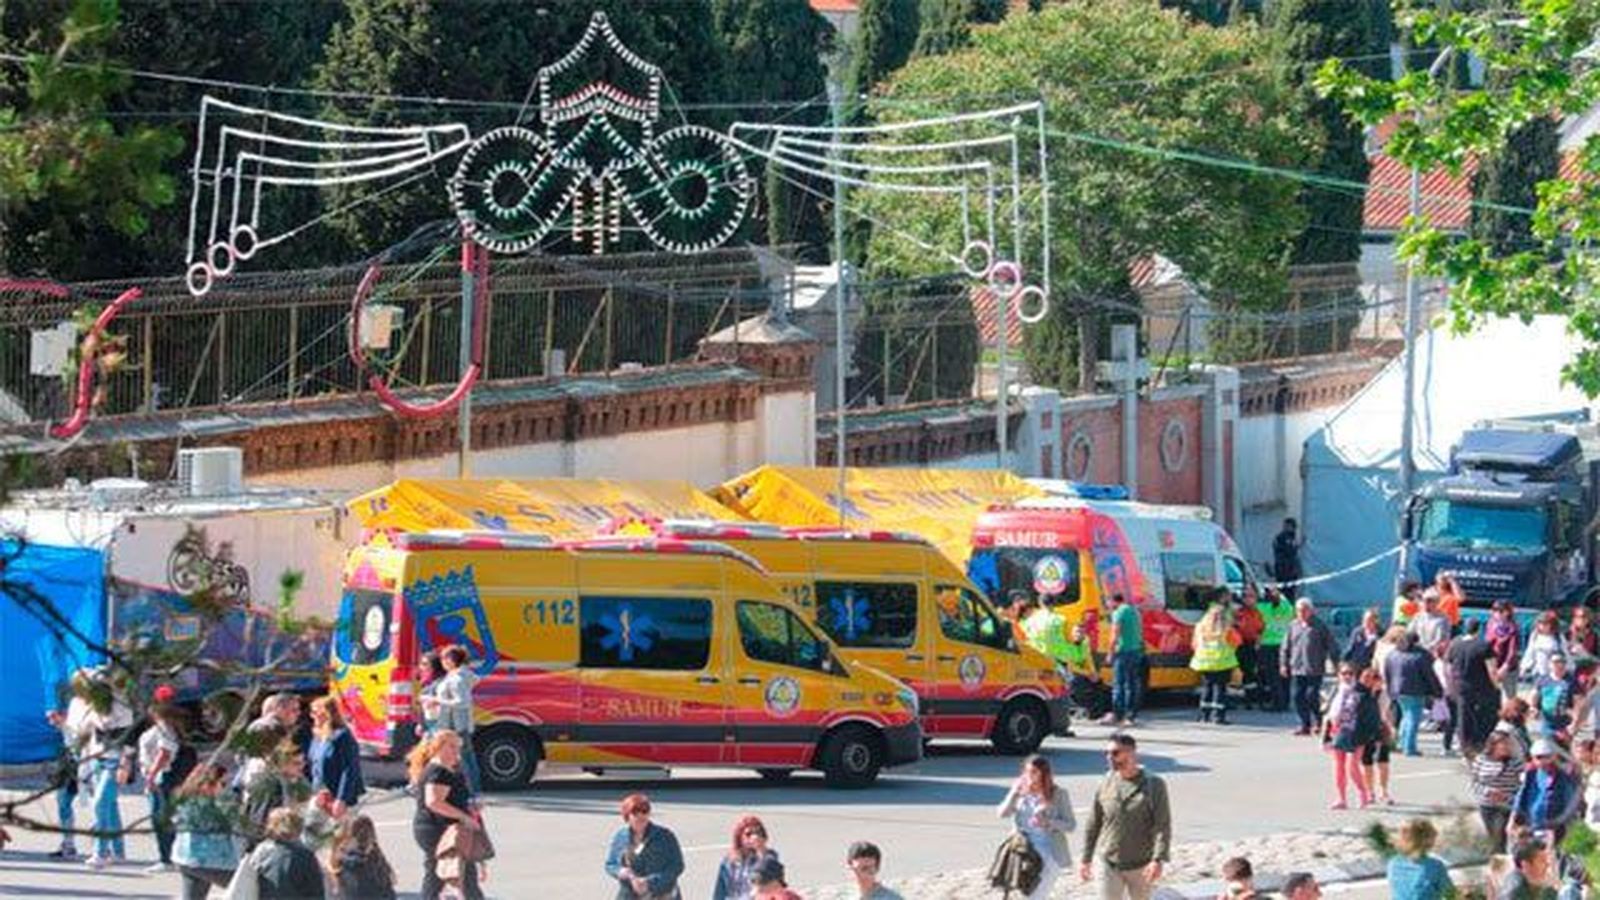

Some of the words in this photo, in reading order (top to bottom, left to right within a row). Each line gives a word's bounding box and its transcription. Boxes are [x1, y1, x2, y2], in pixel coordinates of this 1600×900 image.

[994, 529, 1061, 548] SAMUR
[536, 599, 575, 625] 112
[607, 697, 681, 718] SAMUR
